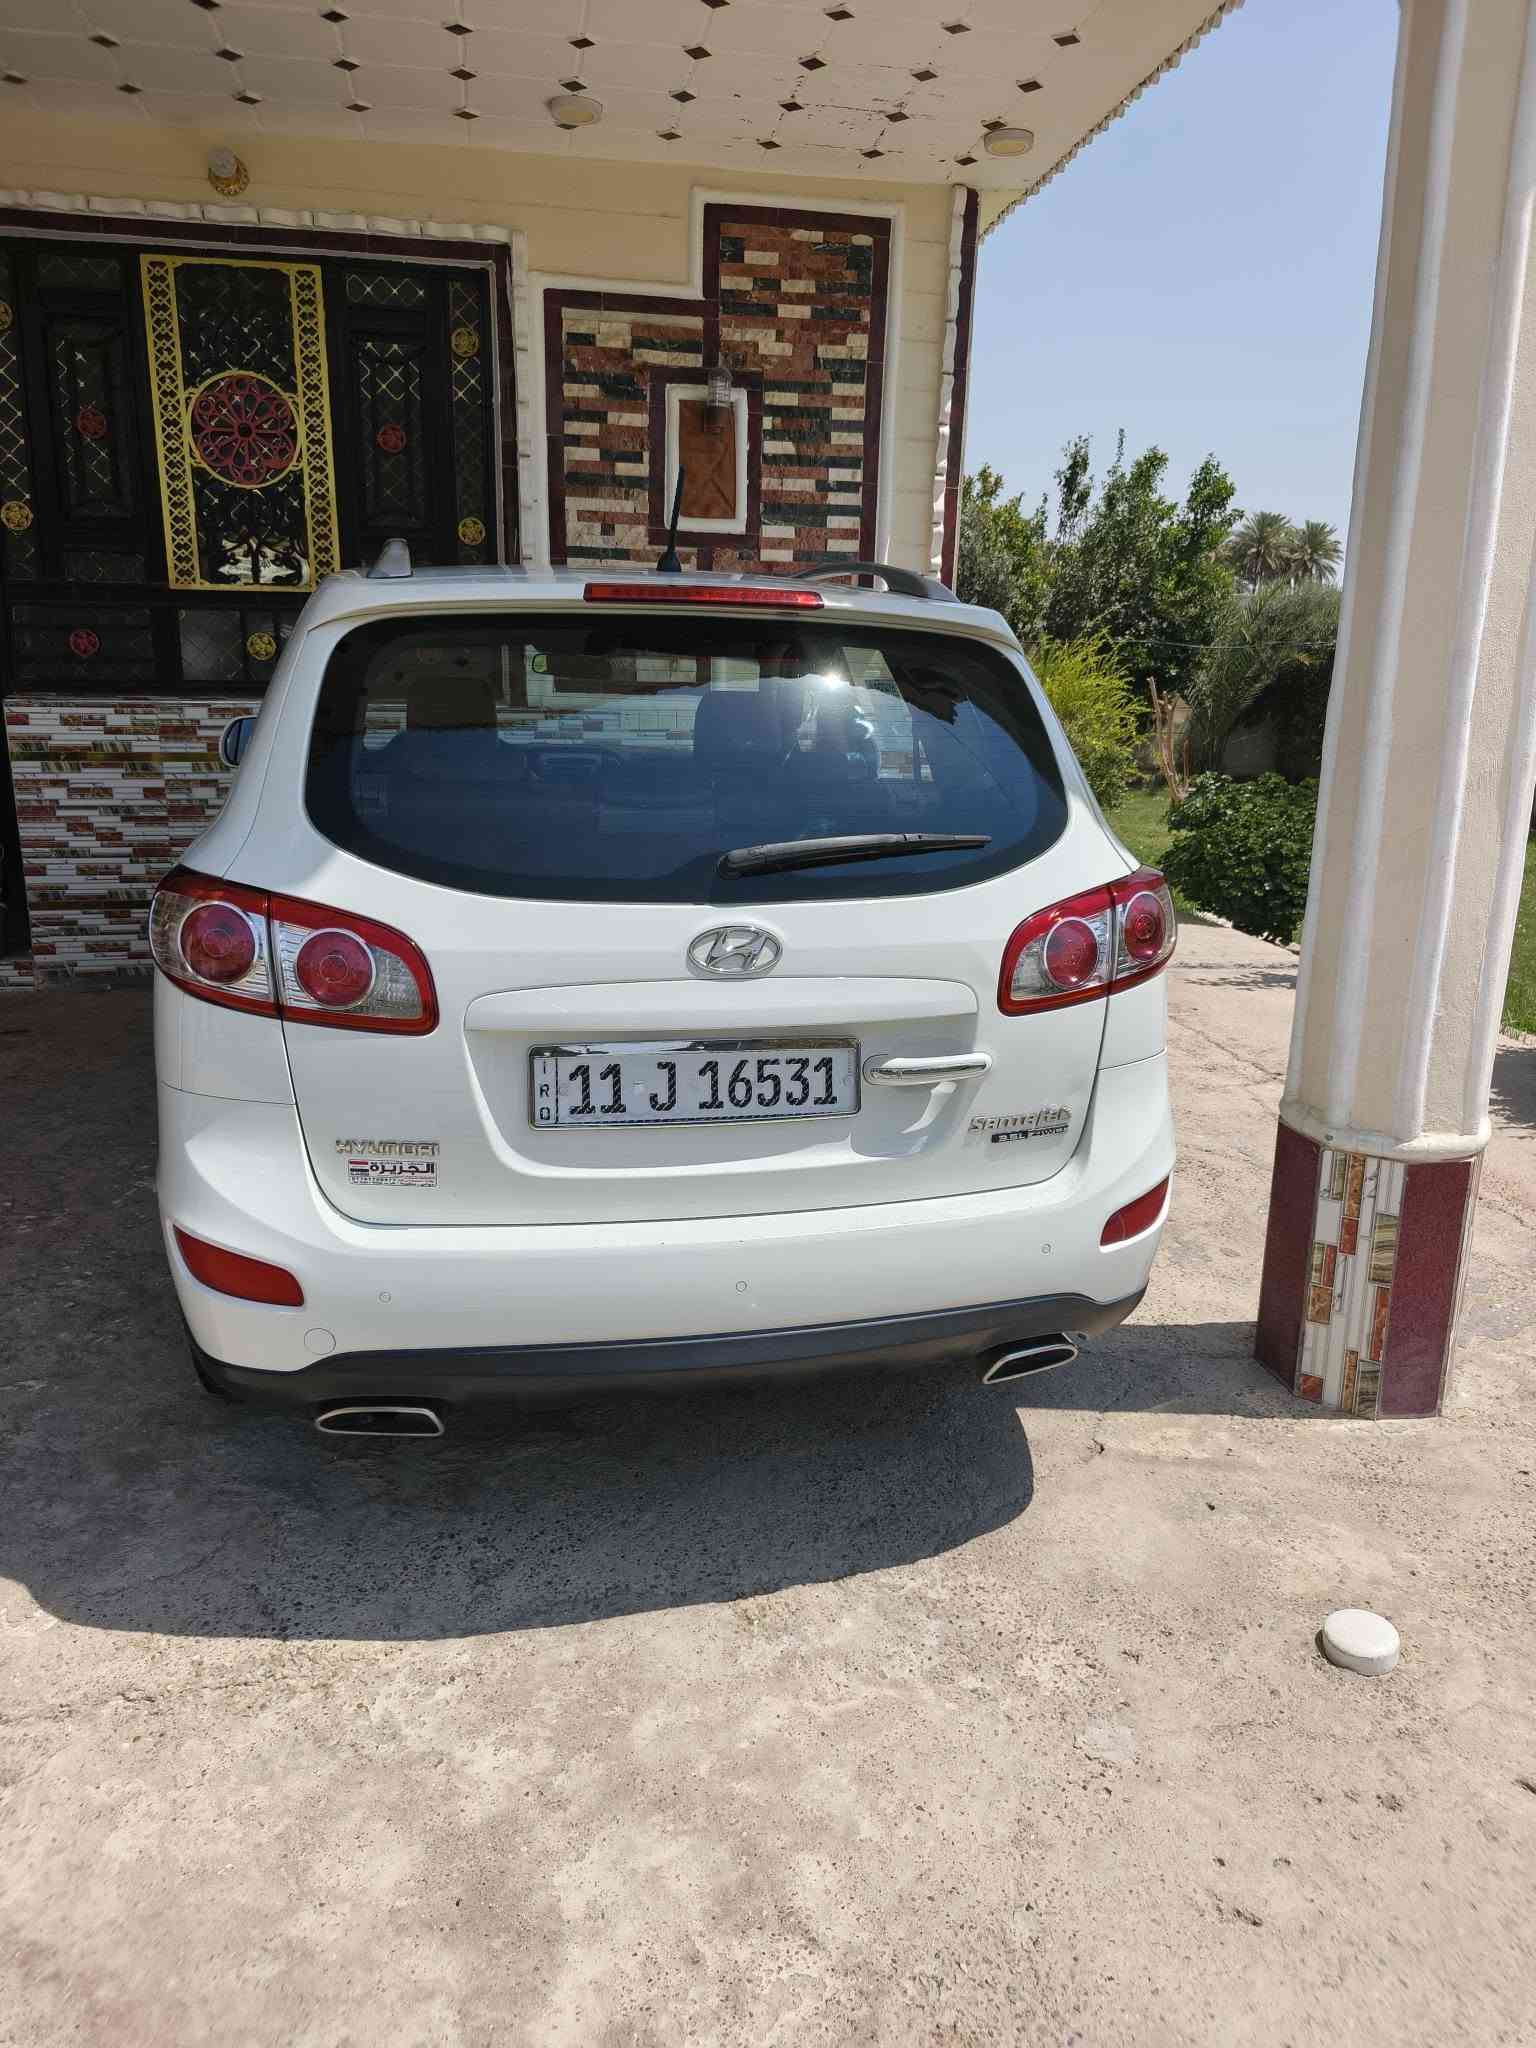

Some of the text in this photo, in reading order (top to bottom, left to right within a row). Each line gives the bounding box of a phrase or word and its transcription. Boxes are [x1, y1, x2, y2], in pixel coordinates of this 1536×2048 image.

[568, 1056, 838, 1115] 11 J 16531
